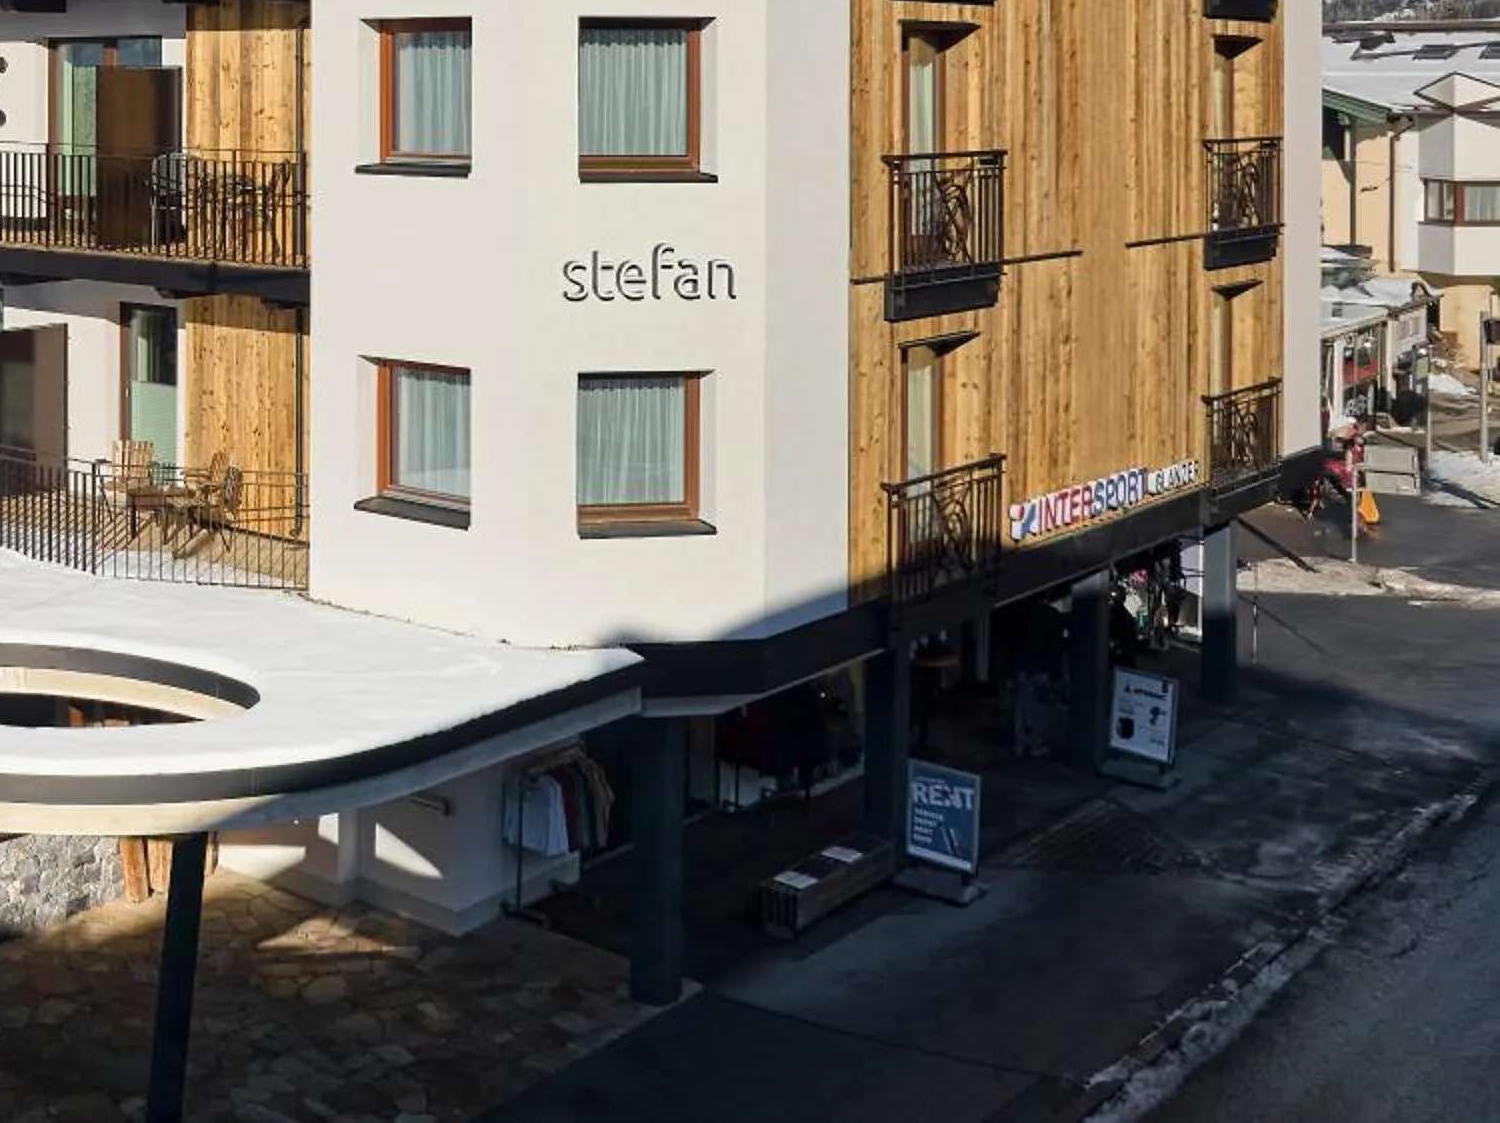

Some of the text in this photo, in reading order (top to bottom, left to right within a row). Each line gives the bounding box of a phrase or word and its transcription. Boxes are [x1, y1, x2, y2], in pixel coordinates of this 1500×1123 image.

[563, 243, 737, 301] stefan
[1037, 467, 1150, 534] INTERSPORT
[912, 783, 975, 810] RENT
